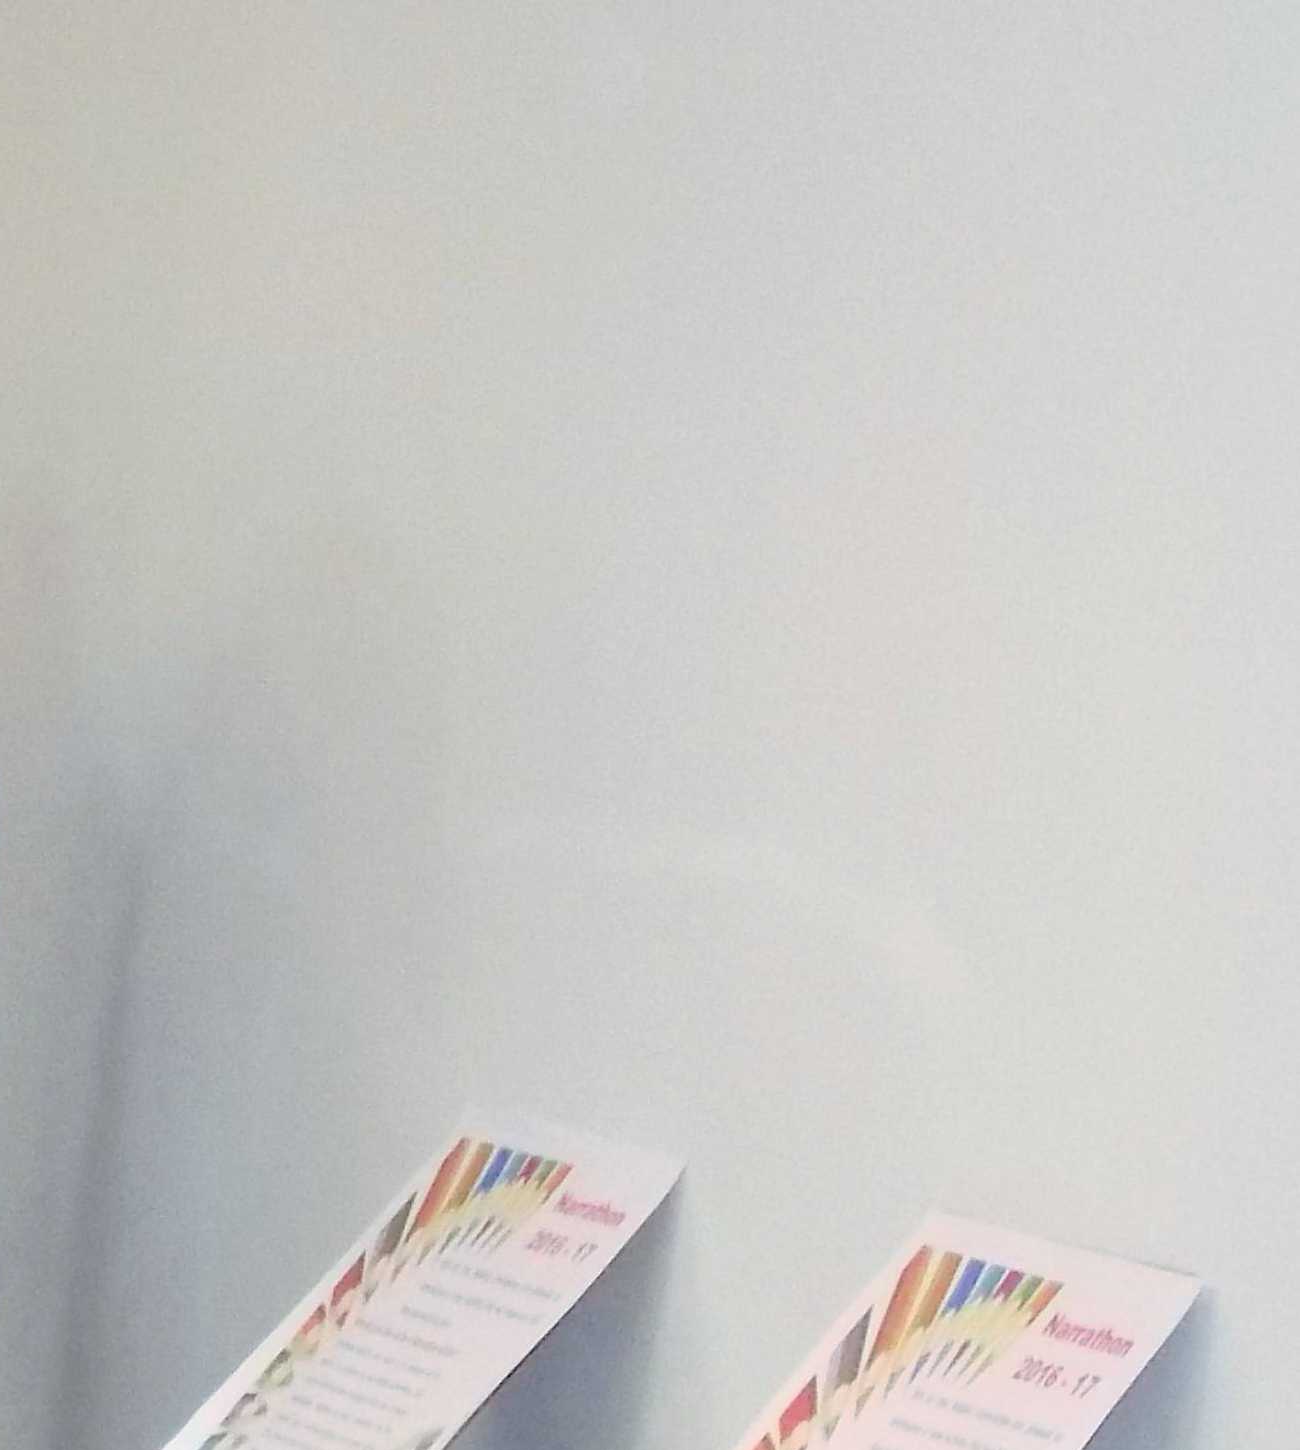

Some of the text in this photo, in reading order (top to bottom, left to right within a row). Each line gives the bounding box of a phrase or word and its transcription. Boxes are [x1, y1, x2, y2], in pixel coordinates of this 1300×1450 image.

[1041, 1312, 1135, 1358] Narrathon
[1011, 1354, 1065, 1389] 2016
[1070, 1371, 1101, 1398] 17
